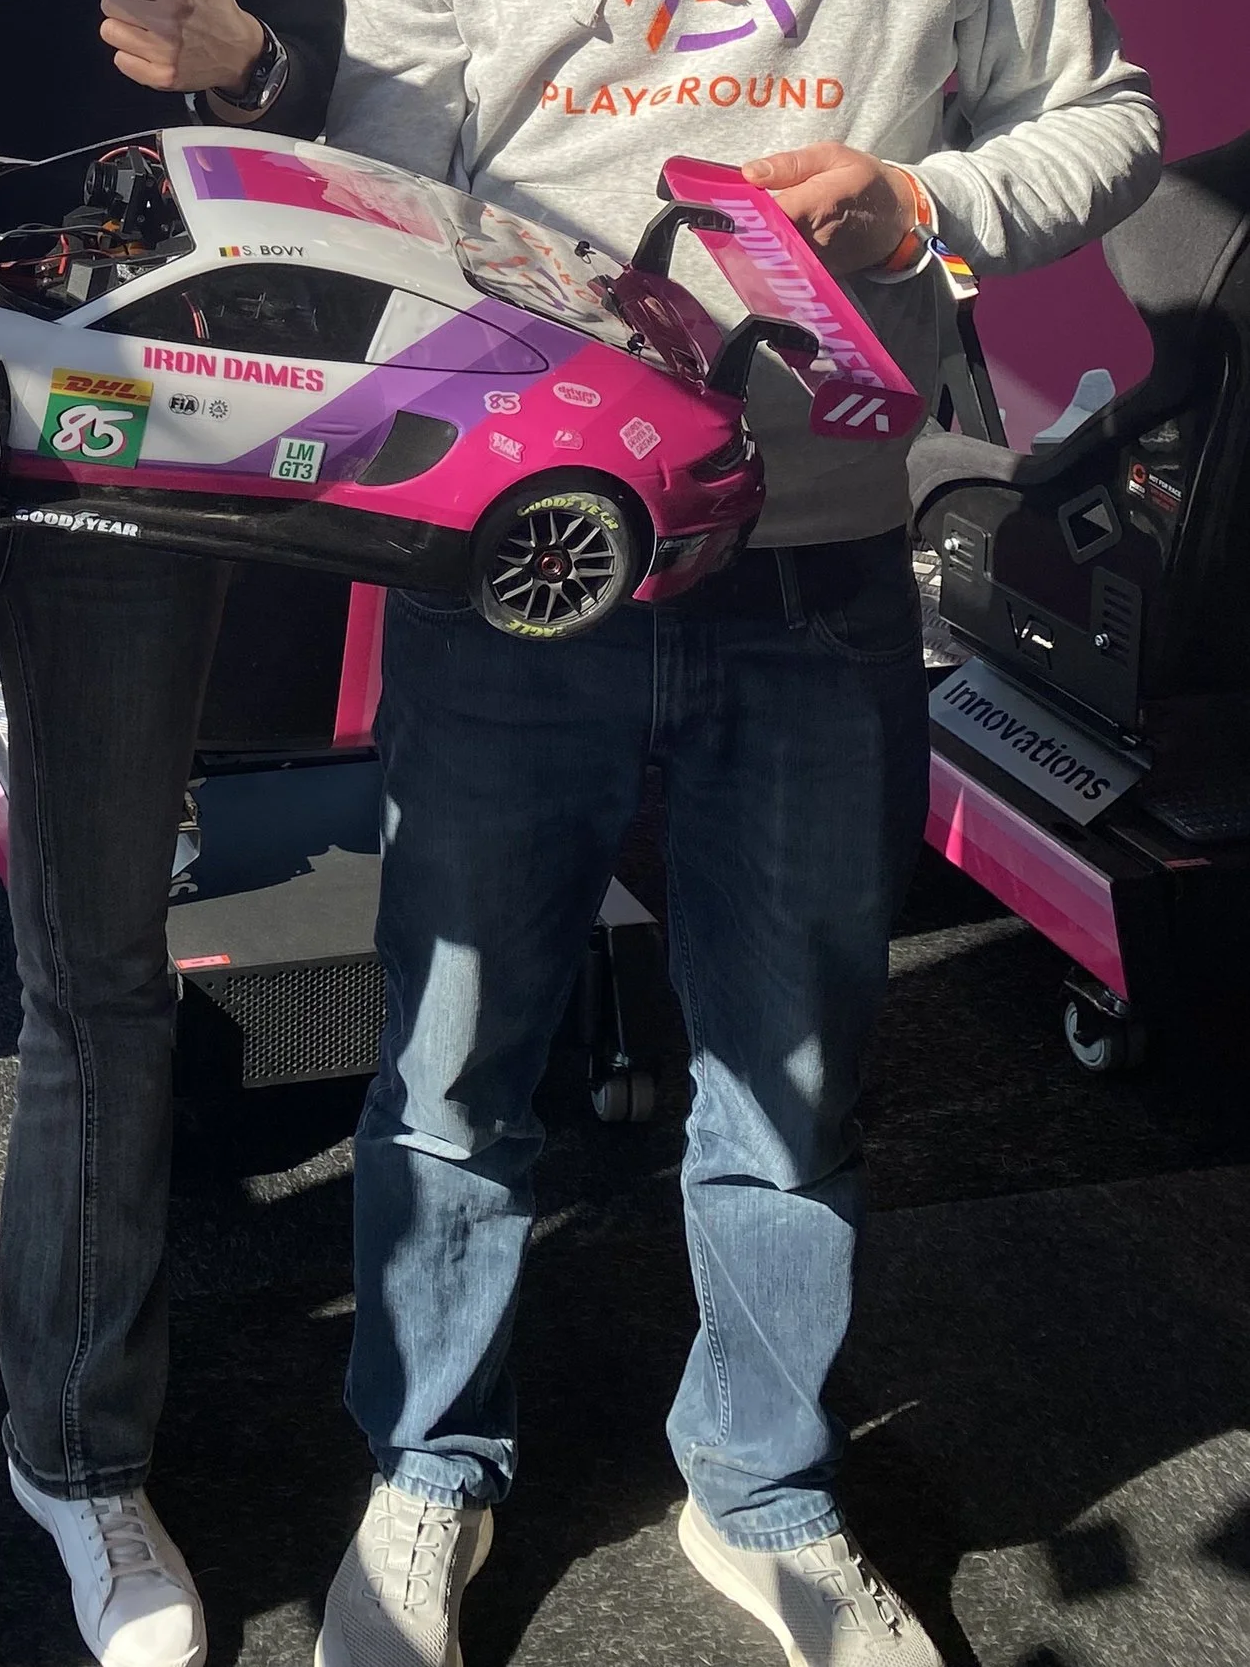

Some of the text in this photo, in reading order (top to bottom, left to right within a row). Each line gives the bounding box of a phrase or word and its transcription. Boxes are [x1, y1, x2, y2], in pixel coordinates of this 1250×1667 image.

[540, 74, 846, 116] PLAYGROUND
[710, 197, 799, 272] IRON
[259, 244, 304, 256] BOVY
[143, 346, 325, 392] IRON DAMES
[62, 375, 138, 400] DHL
[558, 386, 597, 399] driven
[489, 394, 518, 411] 85
[52, 405, 134, 458] 85
[286, 441, 315, 461] LM
[278, 461, 313, 480] GT3
[14, 509, 139, 538] GOODYEAR
[505, 618, 567, 638] EAGLE
[943, 679, 1111, 801] Innovations
